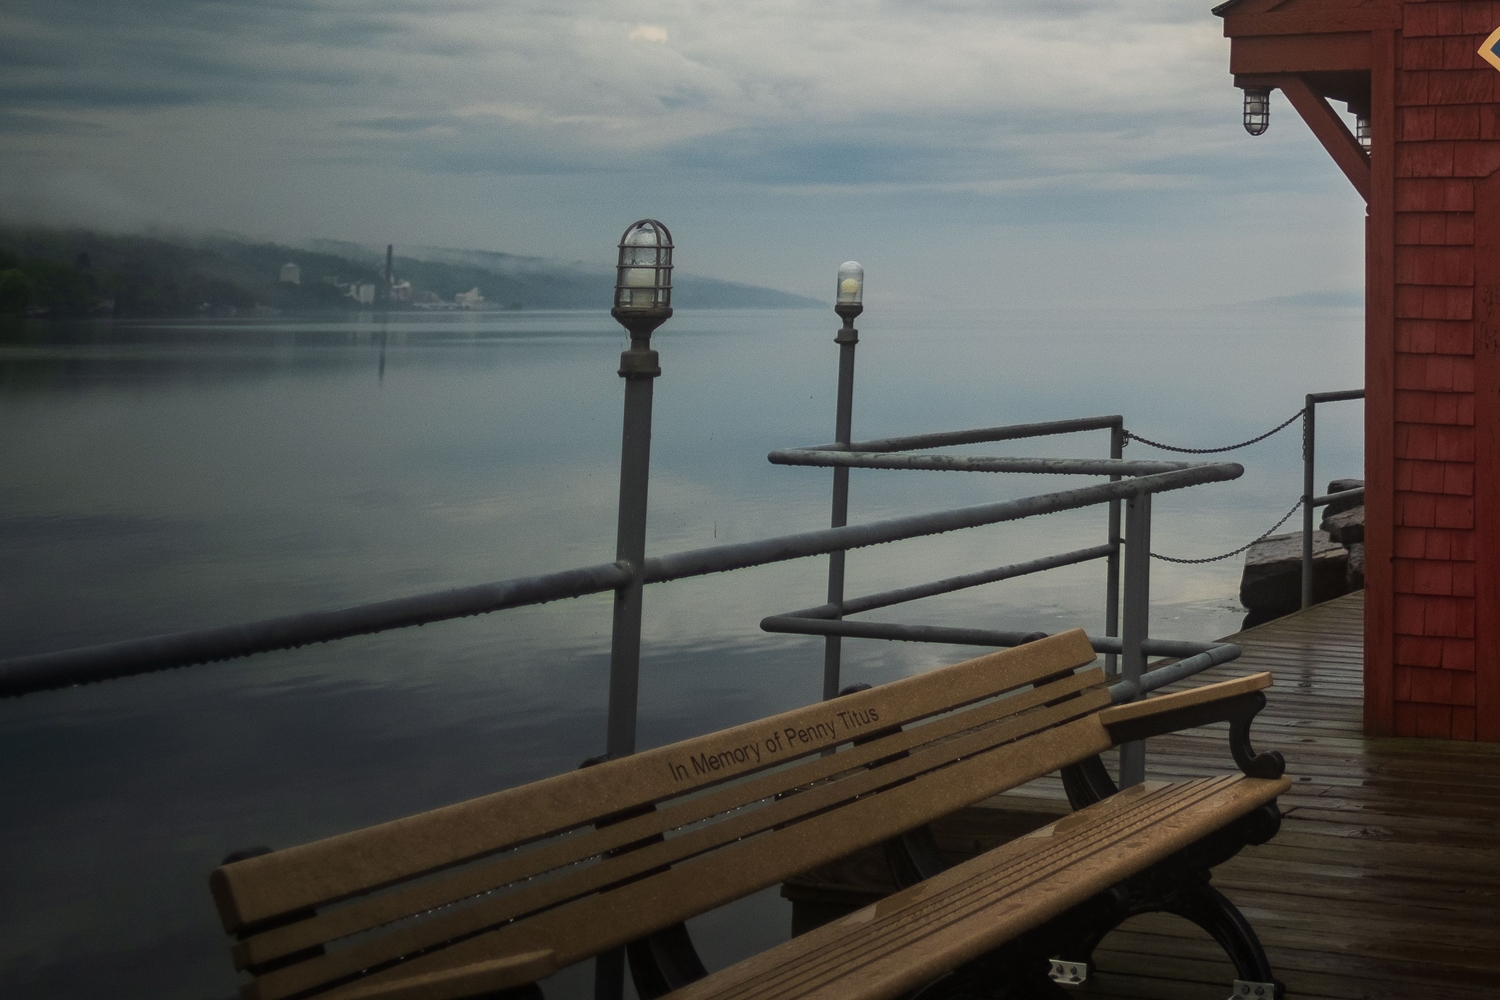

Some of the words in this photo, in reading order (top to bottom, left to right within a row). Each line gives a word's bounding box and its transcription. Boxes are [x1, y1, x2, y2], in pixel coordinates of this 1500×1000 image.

[668, 762, 690, 782] In
[690, 740, 761, 774] Memory
[765, 731, 782, 754] of
[786, 720, 836, 748] Penny
[837, 707, 880, 731] Titus
